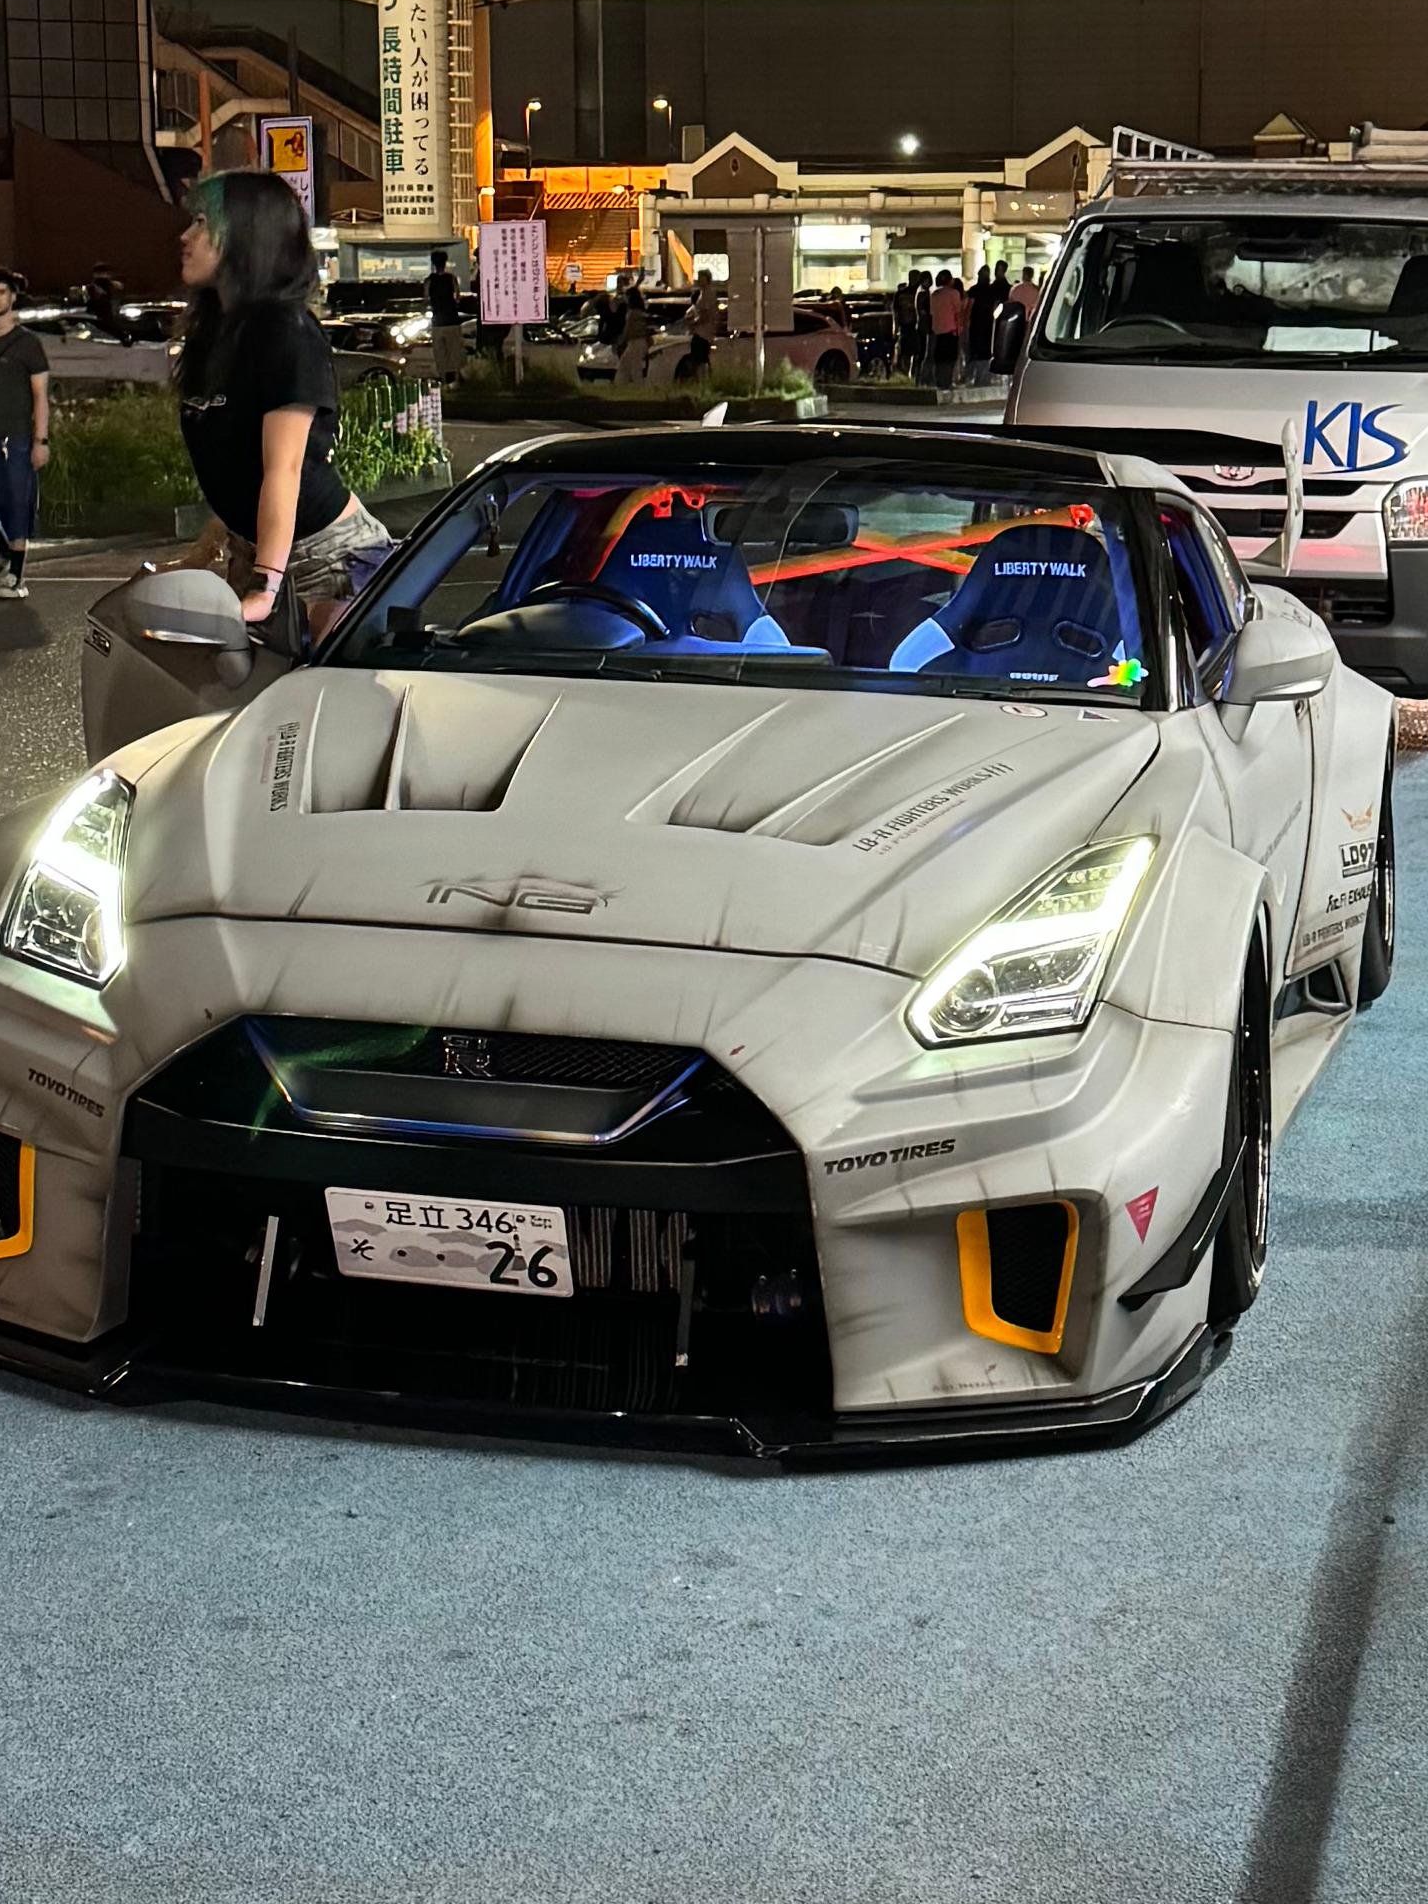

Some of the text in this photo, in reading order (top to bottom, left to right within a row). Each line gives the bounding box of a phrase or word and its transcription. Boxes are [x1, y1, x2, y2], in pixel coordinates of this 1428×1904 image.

[382, 26, 405, 176] 長時間駐車
[1303, 400, 1411, 474] KIS
[630, 553, 718, 569] LIBERTY WALK
[994, 561, 1087, 578] LIBERTY WALK
[851, 828, 894, 853] LB-R
[883, 794, 951, 832] FIGHTERS
[28, 1067, 106, 1119] TOYO TIRES
[824, 1139, 956, 1175] TOYO TIRES
[385, 1201, 450, 1230] 足立
[455, 1207, 514, 1233] 346
[485, 1240, 559, 1289] 26
